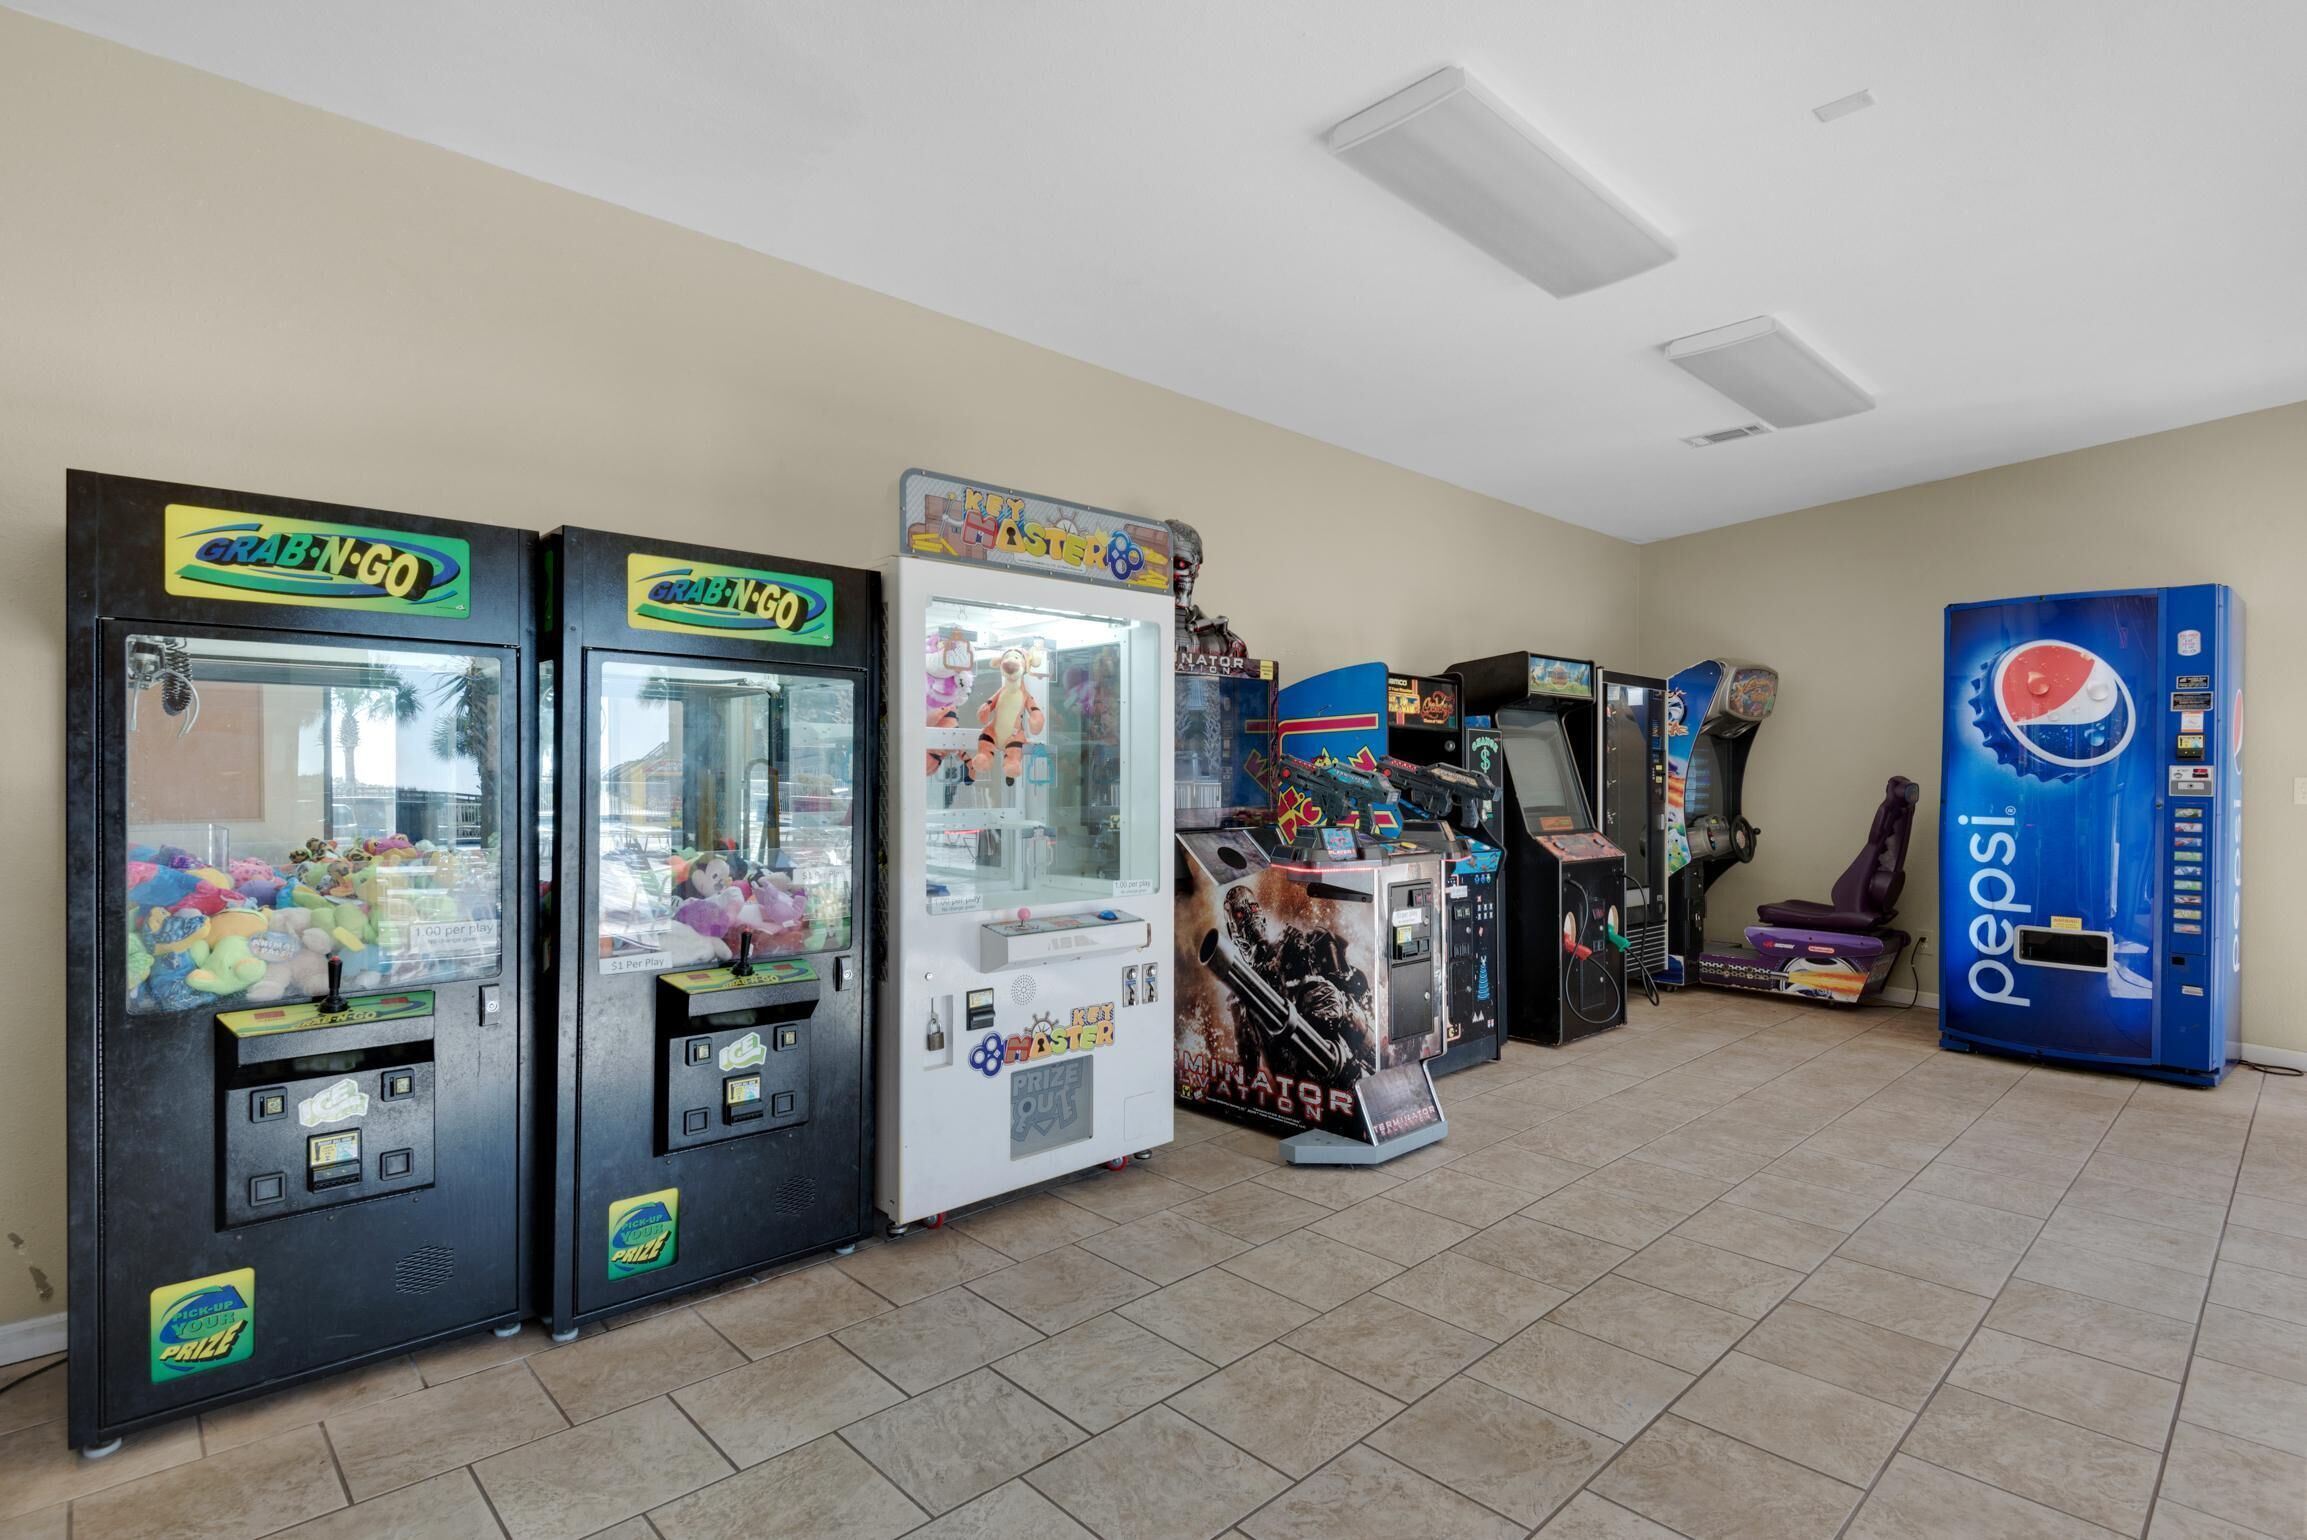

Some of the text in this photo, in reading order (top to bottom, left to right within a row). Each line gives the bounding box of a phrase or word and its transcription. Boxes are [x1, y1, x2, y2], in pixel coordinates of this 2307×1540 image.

[965, 488, 1025, 522] KEY
[961, 509, 1109, 570] MASTER
[1176, 652, 1244, 669] NATOR
[1958, 814, 2032, 1007] pepsi
[415, 921, 494, 939] 1.00 per play
[611, 957, 664, 971] $1 Per Play
[1071, 1001, 1115, 1026] KEY
[1003, 1019, 1115, 1064] MASTER
[1013, 1062, 1083, 1098] PRIZE
[1014, 1085, 1078, 1136] OUT
[1373, 1105, 1436, 1134] TERMINATOR
[621, 1214, 664, 1232] PICK-UP
[611, 1230, 672, 1264] PRIZE
[171, 1311, 235, 1337] YOUR
[172, 1300, 235, 1322] PICK-UP
[160, 1320, 248, 1362] PRIZE
